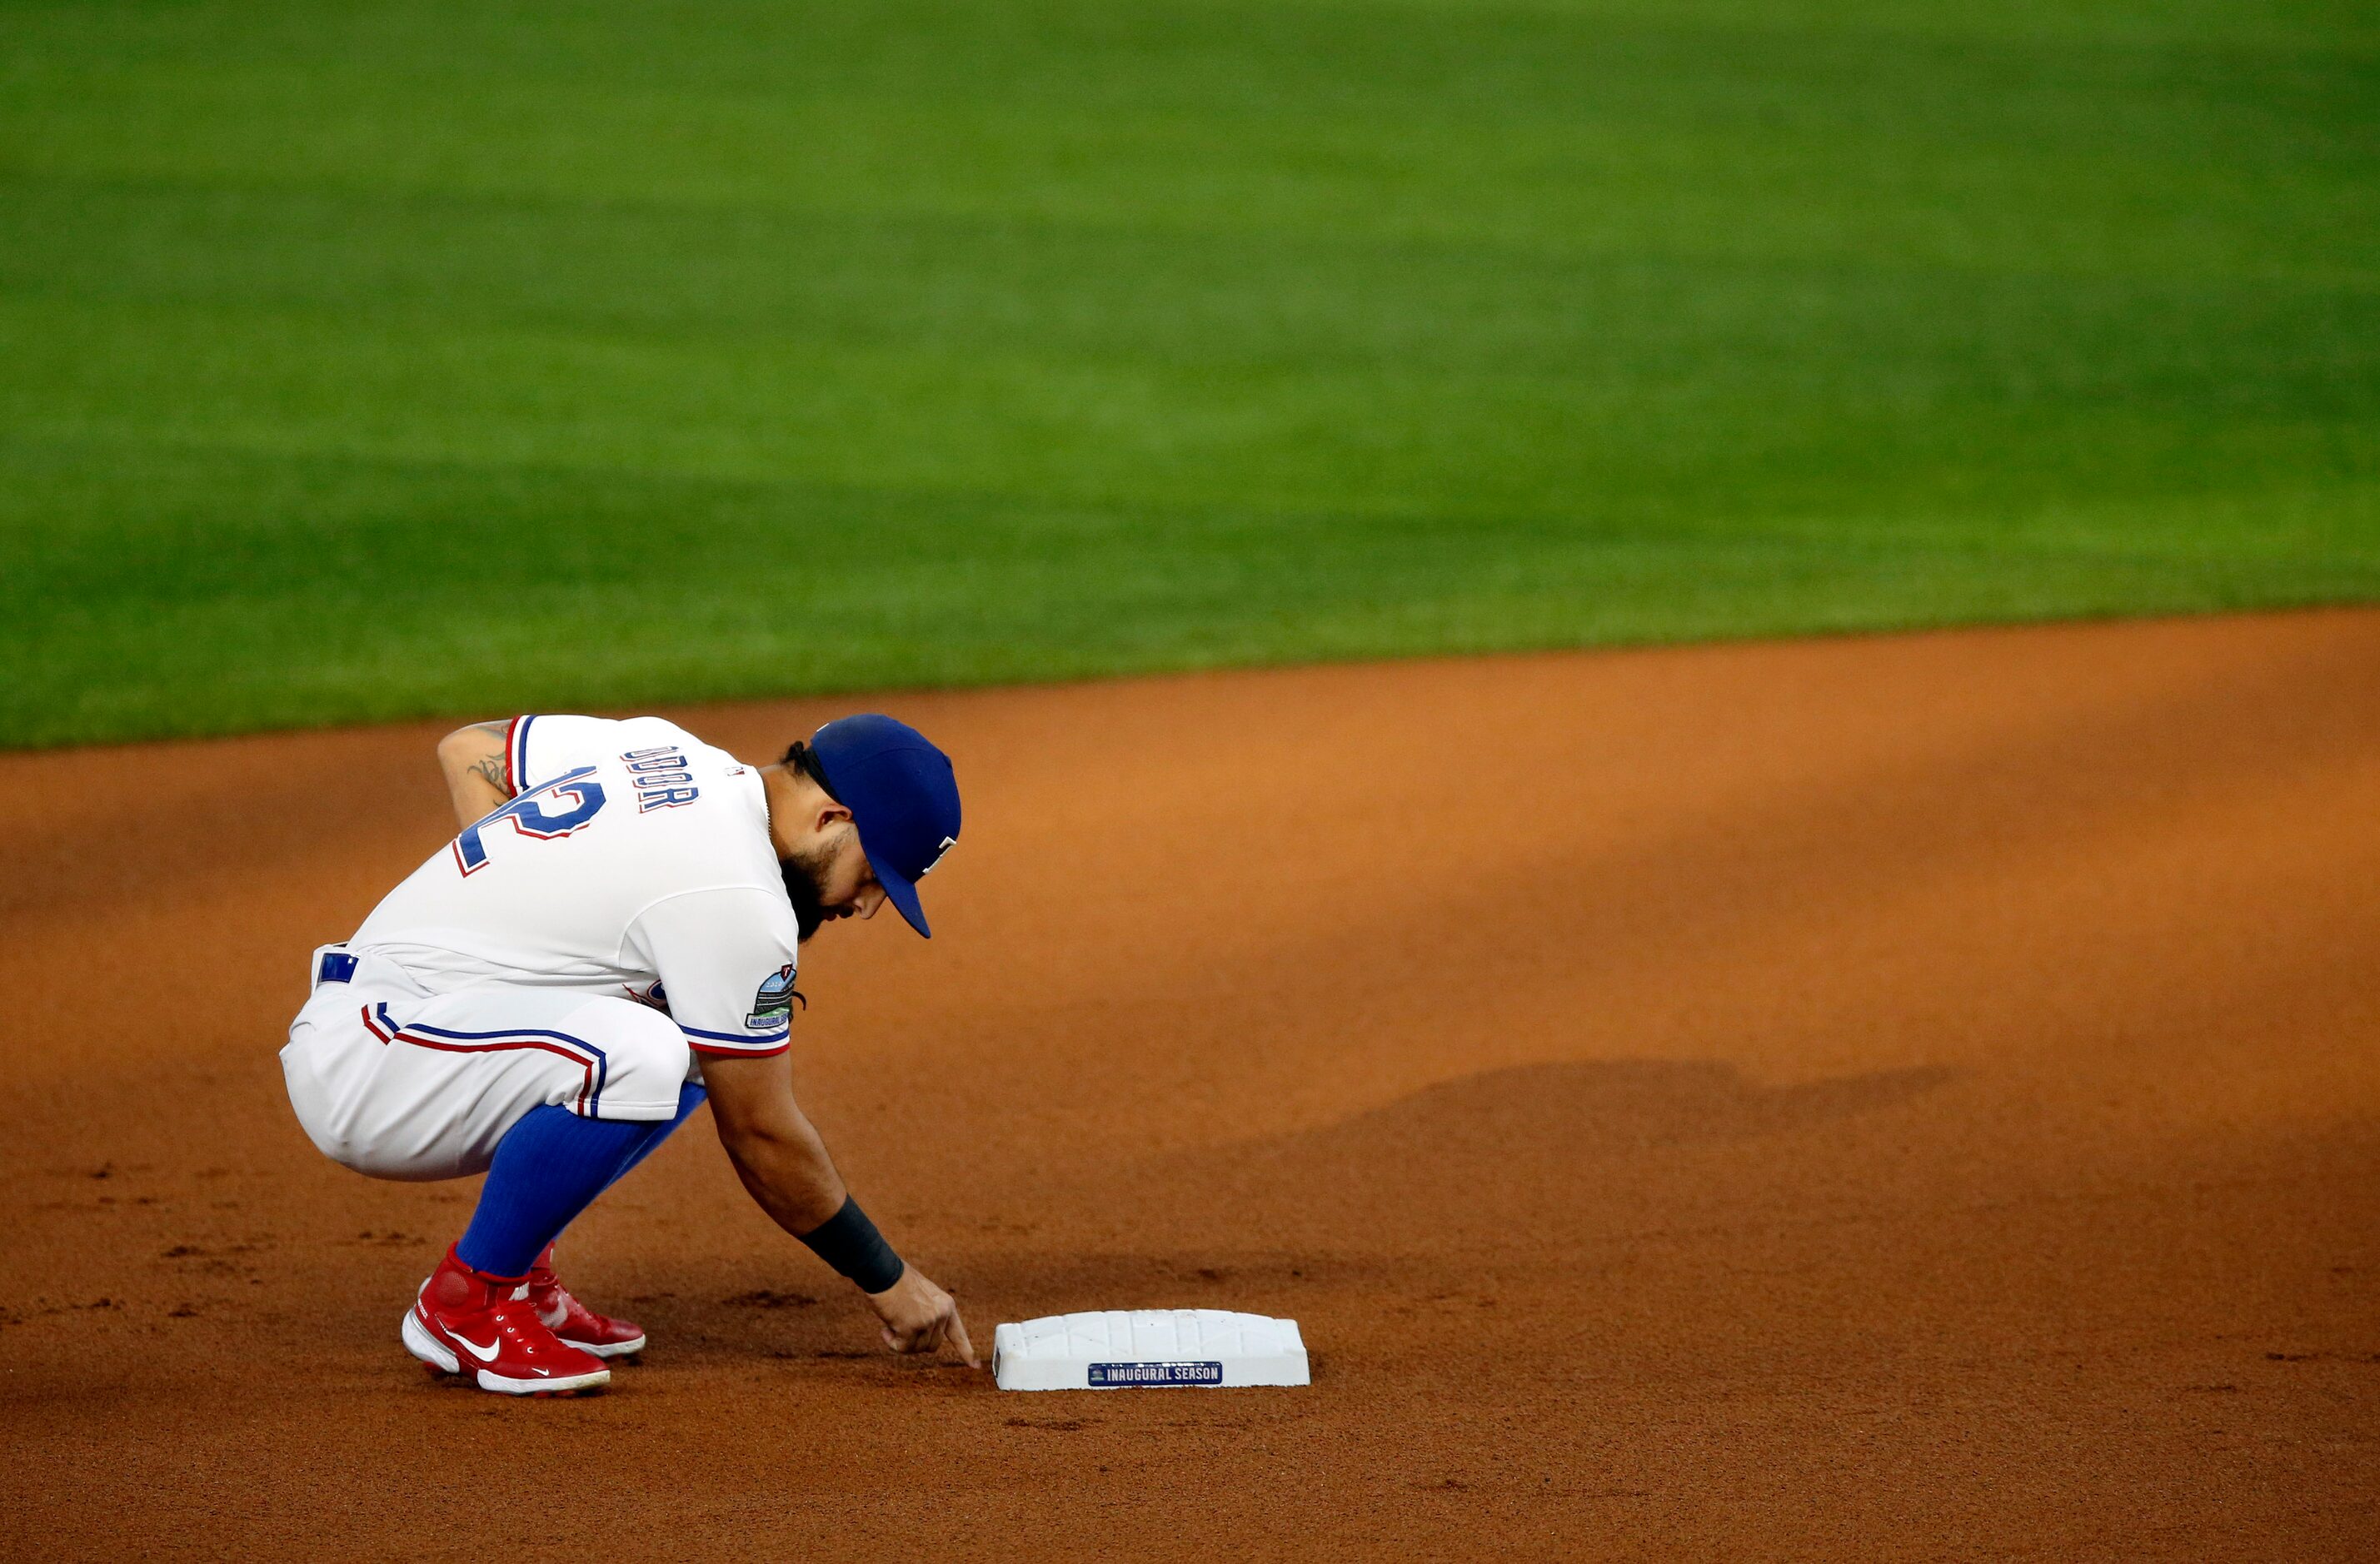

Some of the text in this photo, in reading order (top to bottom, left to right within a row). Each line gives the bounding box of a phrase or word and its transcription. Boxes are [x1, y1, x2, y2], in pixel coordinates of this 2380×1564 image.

[619, 745, 701, 814] ODOR
[452, 765, 606, 879] 12
[1107, 1367, 1219, 1382] INAUGURAL SEASON
